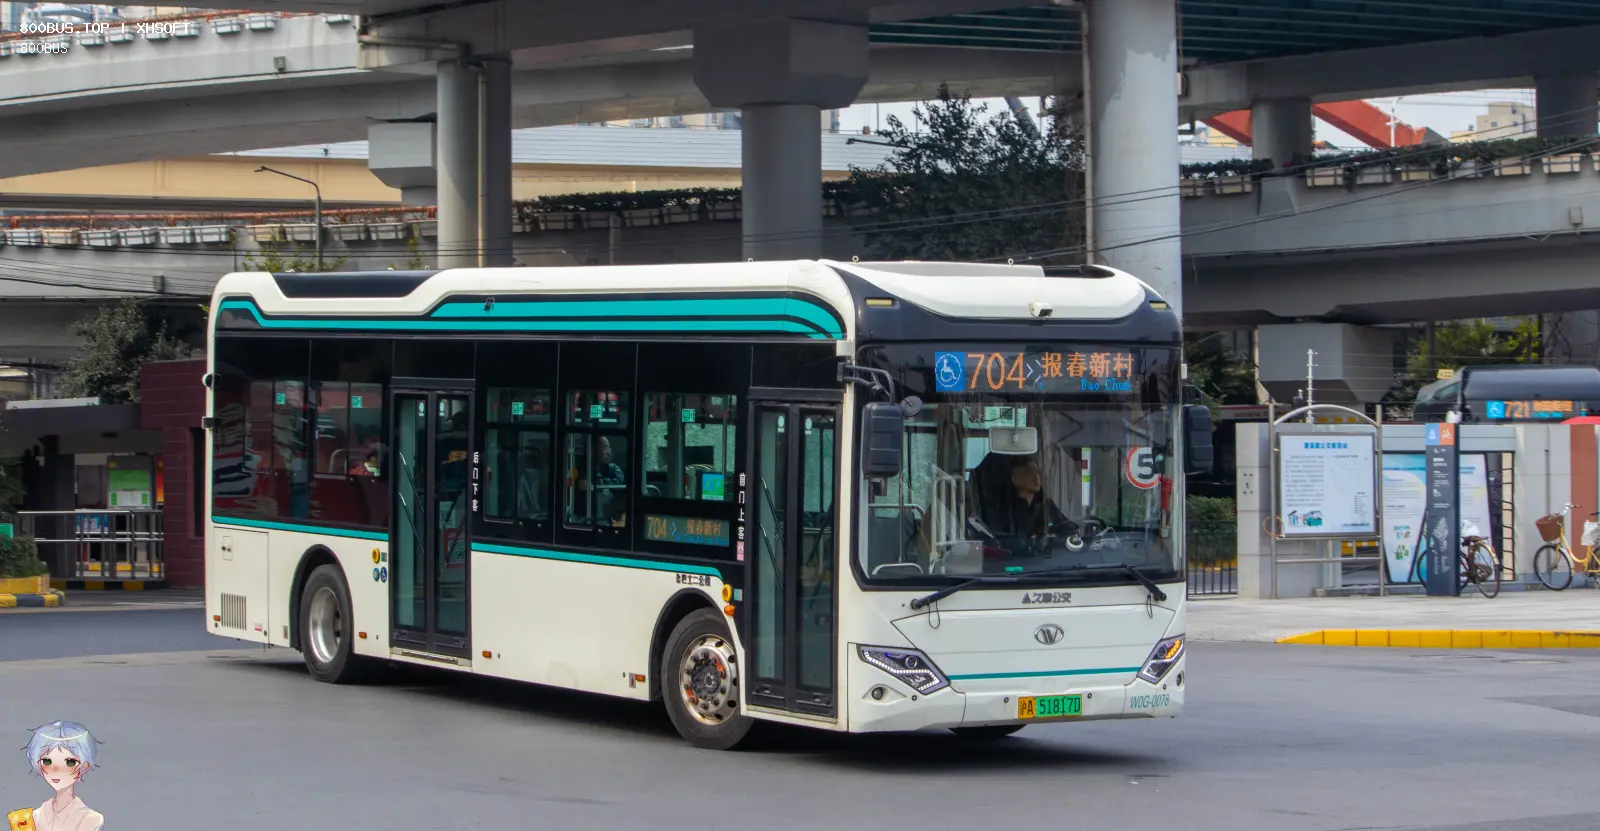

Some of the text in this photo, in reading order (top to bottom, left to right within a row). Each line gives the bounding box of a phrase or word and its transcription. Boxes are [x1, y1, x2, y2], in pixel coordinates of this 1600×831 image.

[967, 352, 1026, 390] 704
[1041, 351, 1135, 378] 报春新村
[1081, 378, 1100, 391] Bao
[1504, 401, 1530, 418] 721
[647, 516, 667, 539] 704
[1039, 696, 1081, 715] 51817D
